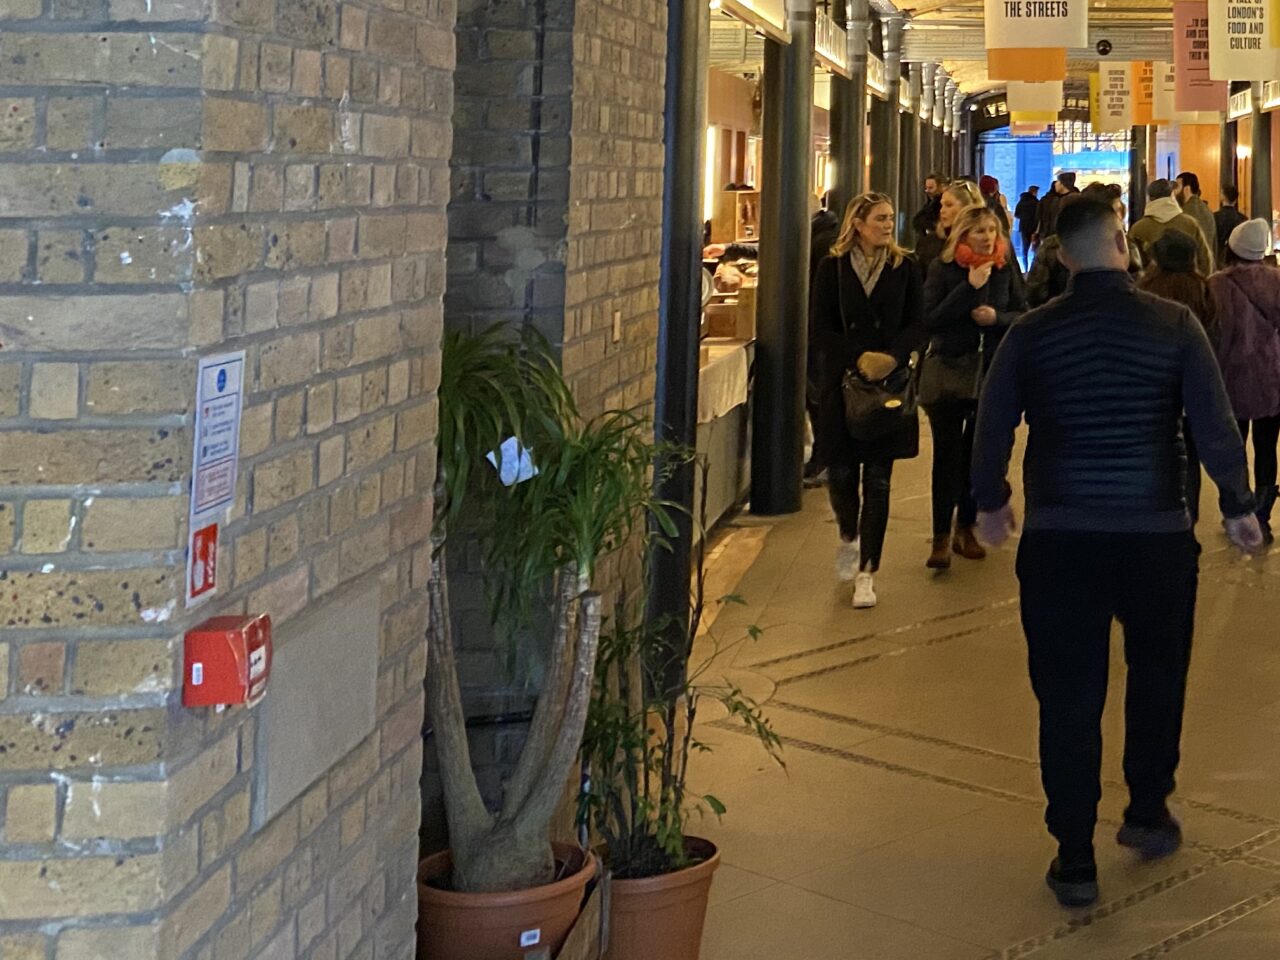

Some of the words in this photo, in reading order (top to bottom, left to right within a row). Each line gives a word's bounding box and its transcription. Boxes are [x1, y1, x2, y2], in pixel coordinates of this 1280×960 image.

[1004, 1, 1024, 18] THE
[1025, 1, 1068, 18] STREETS
[1227, 6, 1264, 19] LONDON'S
[1227, 22, 1246, 34] FOOD
[1249, 22, 1264, 35] AND
[1229, 37, 1262, 50] CULTURE
